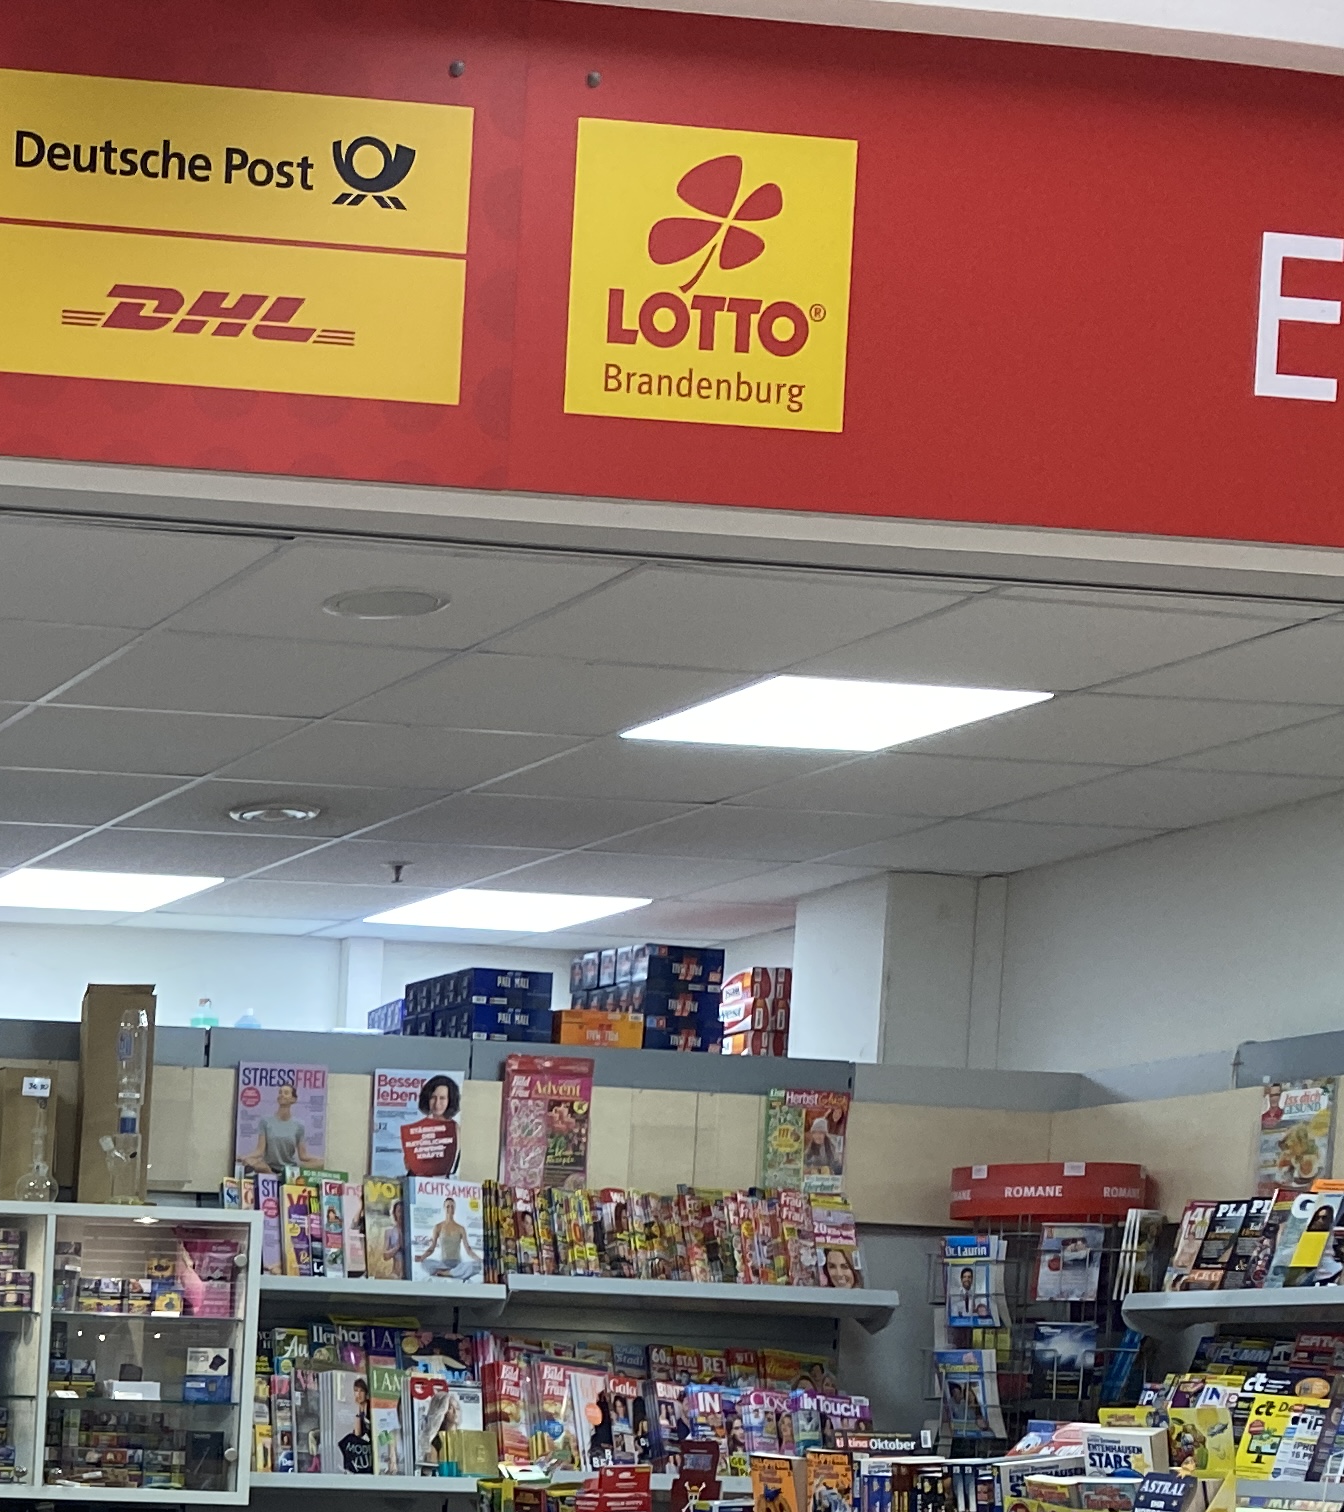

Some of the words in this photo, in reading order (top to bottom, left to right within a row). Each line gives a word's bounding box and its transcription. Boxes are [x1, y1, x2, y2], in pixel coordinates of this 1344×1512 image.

[13, 129, 215, 185] Deutsche
[224, 144, 314, 193] Post
[105, 283, 316, 345] DHL
[602, 362, 806, 413] Brandenburg
[241, 1067, 326, 1090] STRESSFREI
[377, 1074, 426, 1089] Besser
[377, 1088, 419, 1102] leben
[533, 1079, 581, 1098] Advent
[1004, 1185, 1063, 1199] ROMANE
[869, 1437, 916, 1453] Oktober
[1089, 1452, 1132, 1470] STARS
[1141, 1478, 1186, 1498] ASTRAL
